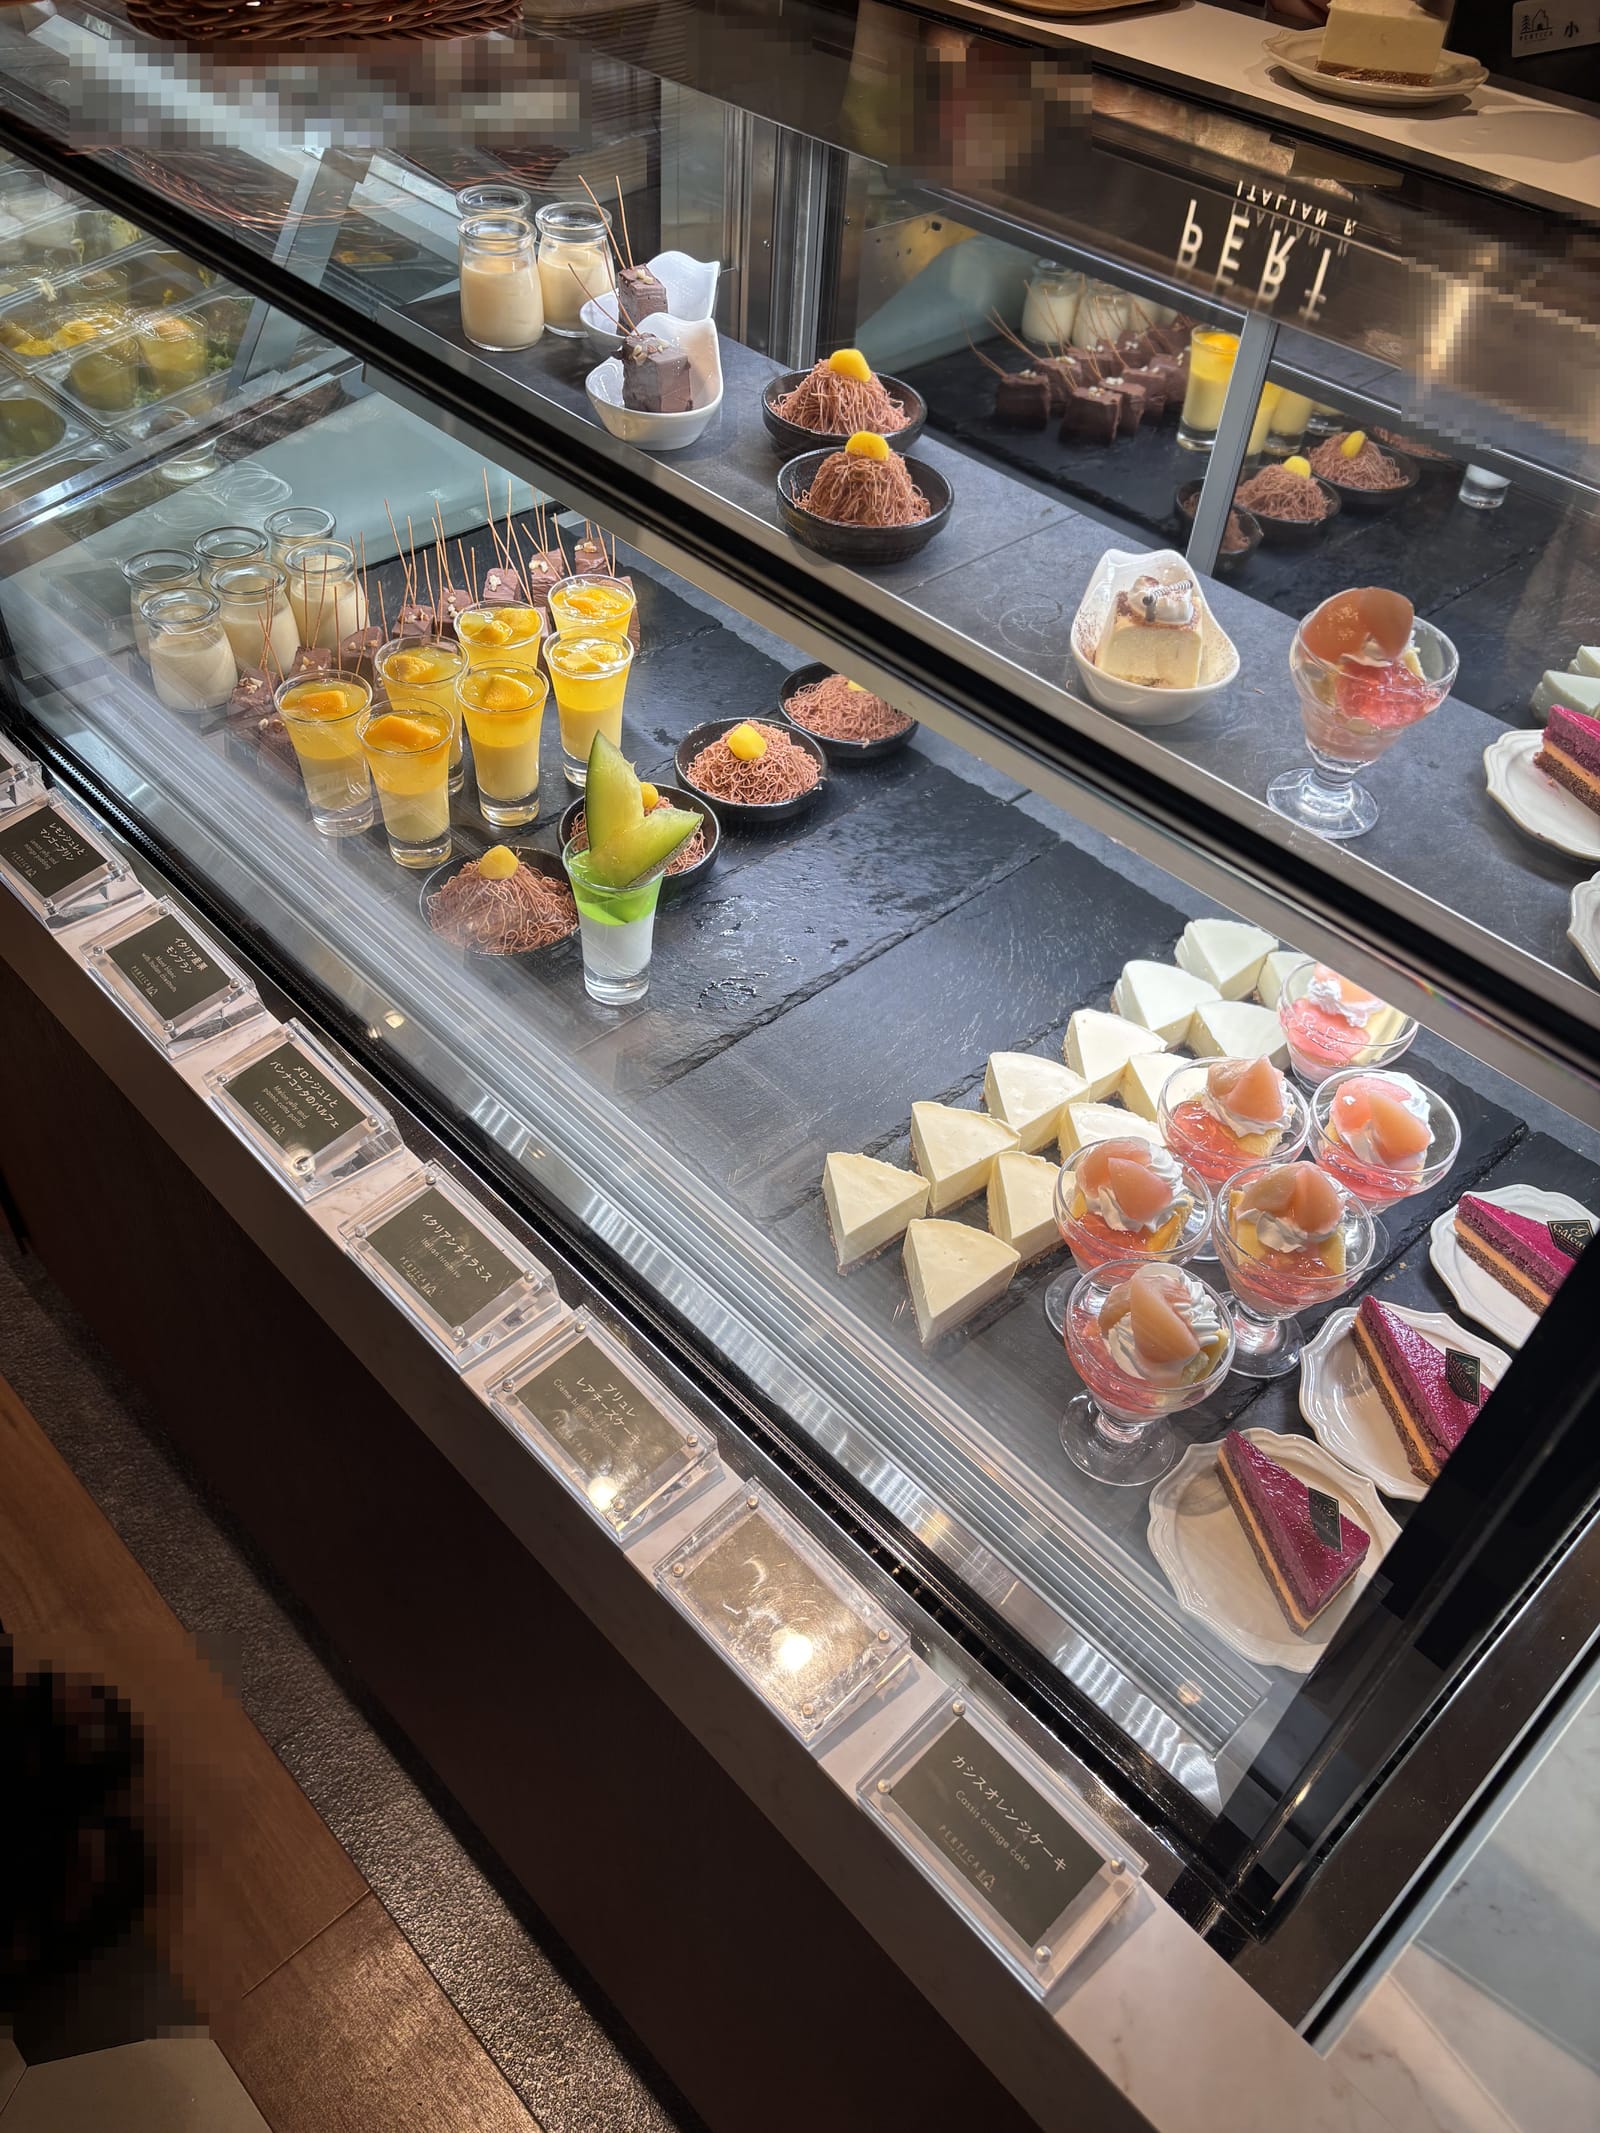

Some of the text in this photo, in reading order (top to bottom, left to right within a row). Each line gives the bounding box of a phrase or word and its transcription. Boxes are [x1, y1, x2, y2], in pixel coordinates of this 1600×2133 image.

[1563, 20, 1579, 38] 小
[166, 946, 192, 974] モンブラン
[294, 1067, 338, 1108] メロンジュレと
[422, 1214, 492, 1282] イタリアンティラミス
[577, 1377, 640, 1445] レアチーズケーキ
[953, 1756, 1065, 1870] カシスオレンジケーキ
[955, 1790, 980, 1818] Cassis
[980, 1818, 1010, 1849] orange
[1010, 1847, 1030, 1870] cake
